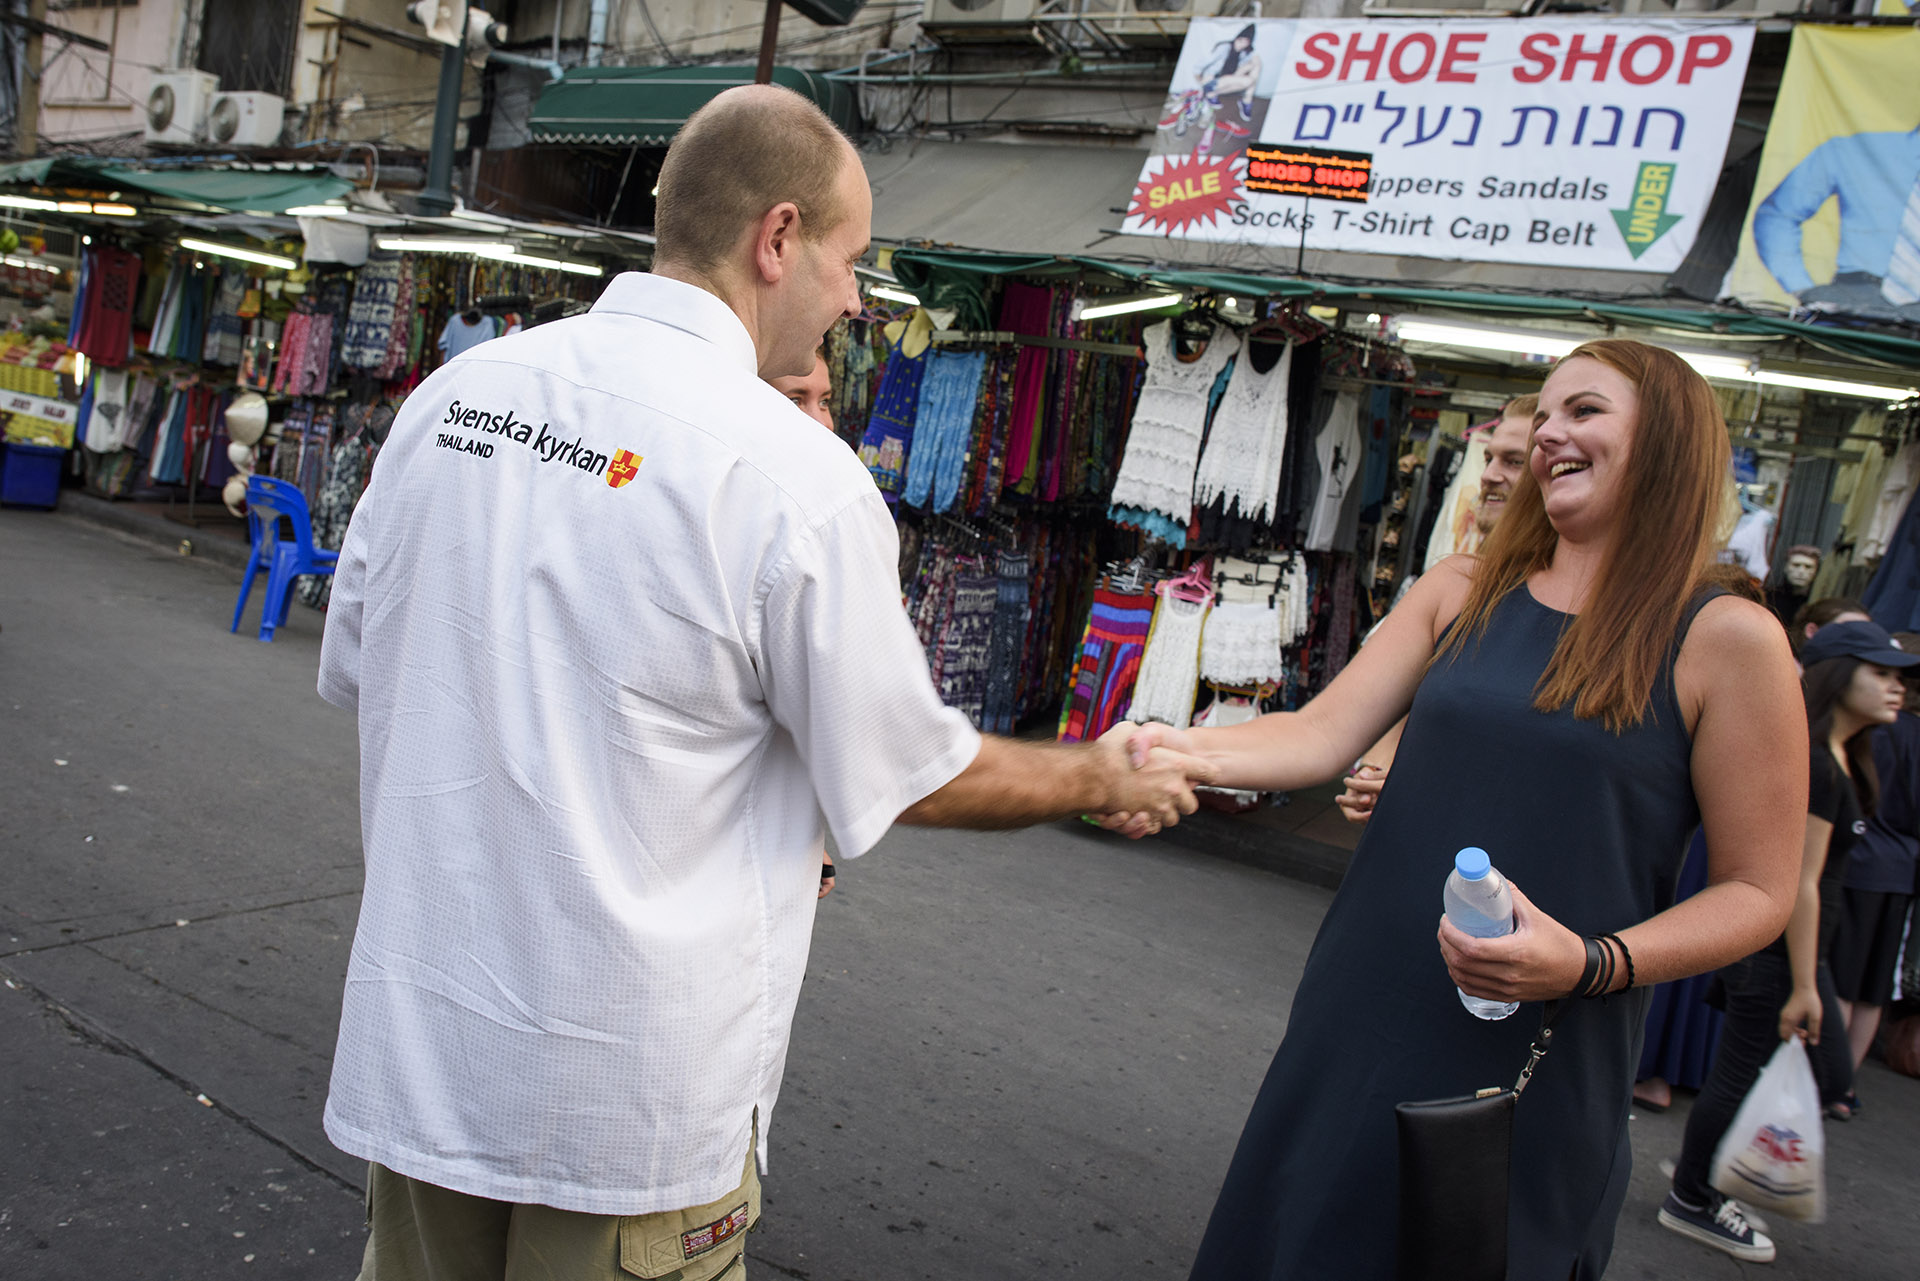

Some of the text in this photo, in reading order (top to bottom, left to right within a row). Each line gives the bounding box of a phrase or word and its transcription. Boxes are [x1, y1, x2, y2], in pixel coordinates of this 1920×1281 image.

[1296, 32, 1733, 85] SHOE SHOP
[1501, 105, 1686, 151] חנות
[1149, 171, 1222, 209] SALE
[1249, 160, 1368, 188] SHOES SHOP
[1369, 172, 1609, 201] ippers Sandals
[1626, 163, 1672, 244] UNDER
[1231, 204, 1599, 246] Socks T-Shirt Cap Belt
[436, 433, 495, 459] THAILAND
[443, 399, 608, 477] Svenska kyrkan
